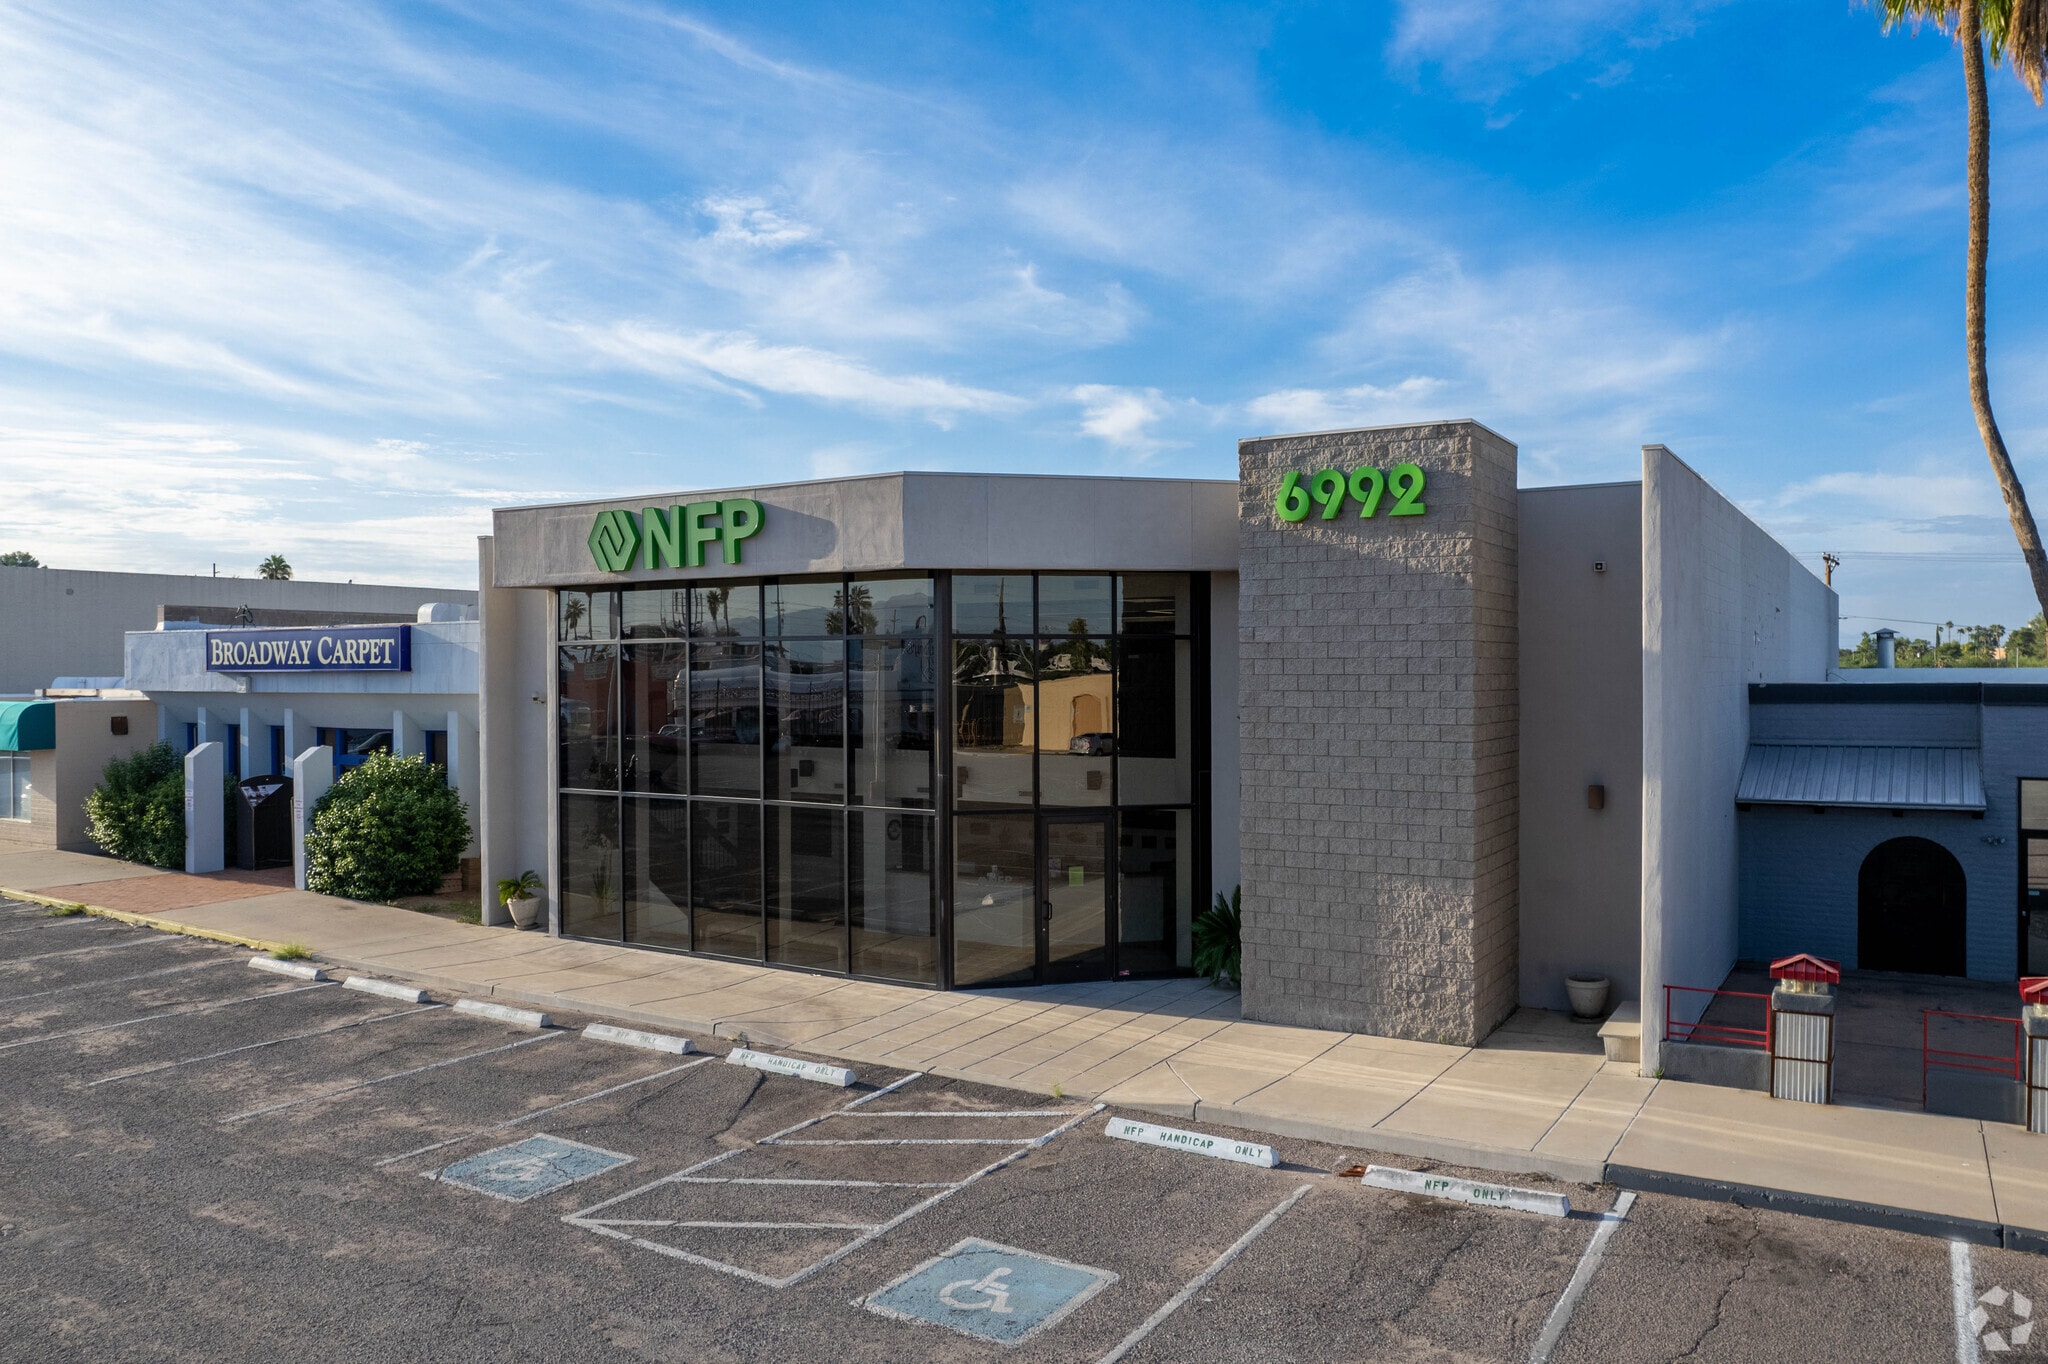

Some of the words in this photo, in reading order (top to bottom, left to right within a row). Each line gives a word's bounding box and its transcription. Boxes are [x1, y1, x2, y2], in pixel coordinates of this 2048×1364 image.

[1275, 463, 1426, 522] 6992
[642, 498, 766, 570] NFP
[740, 1051, 755, 1061] NFP
[767, 1057, 807, 1071] HANDICAP
[814, 1066, 836, 1077] ONLY
[1123, 1125, 1145, 1136] NFP
[1159, 1131, 1215, 1150] HANDICAP
[1234, 1145, 1264, 1159] ONLY
[1424, 1179, 1449, 1192] NFP
[1473, 1188, 1505, 1201] ONLY
